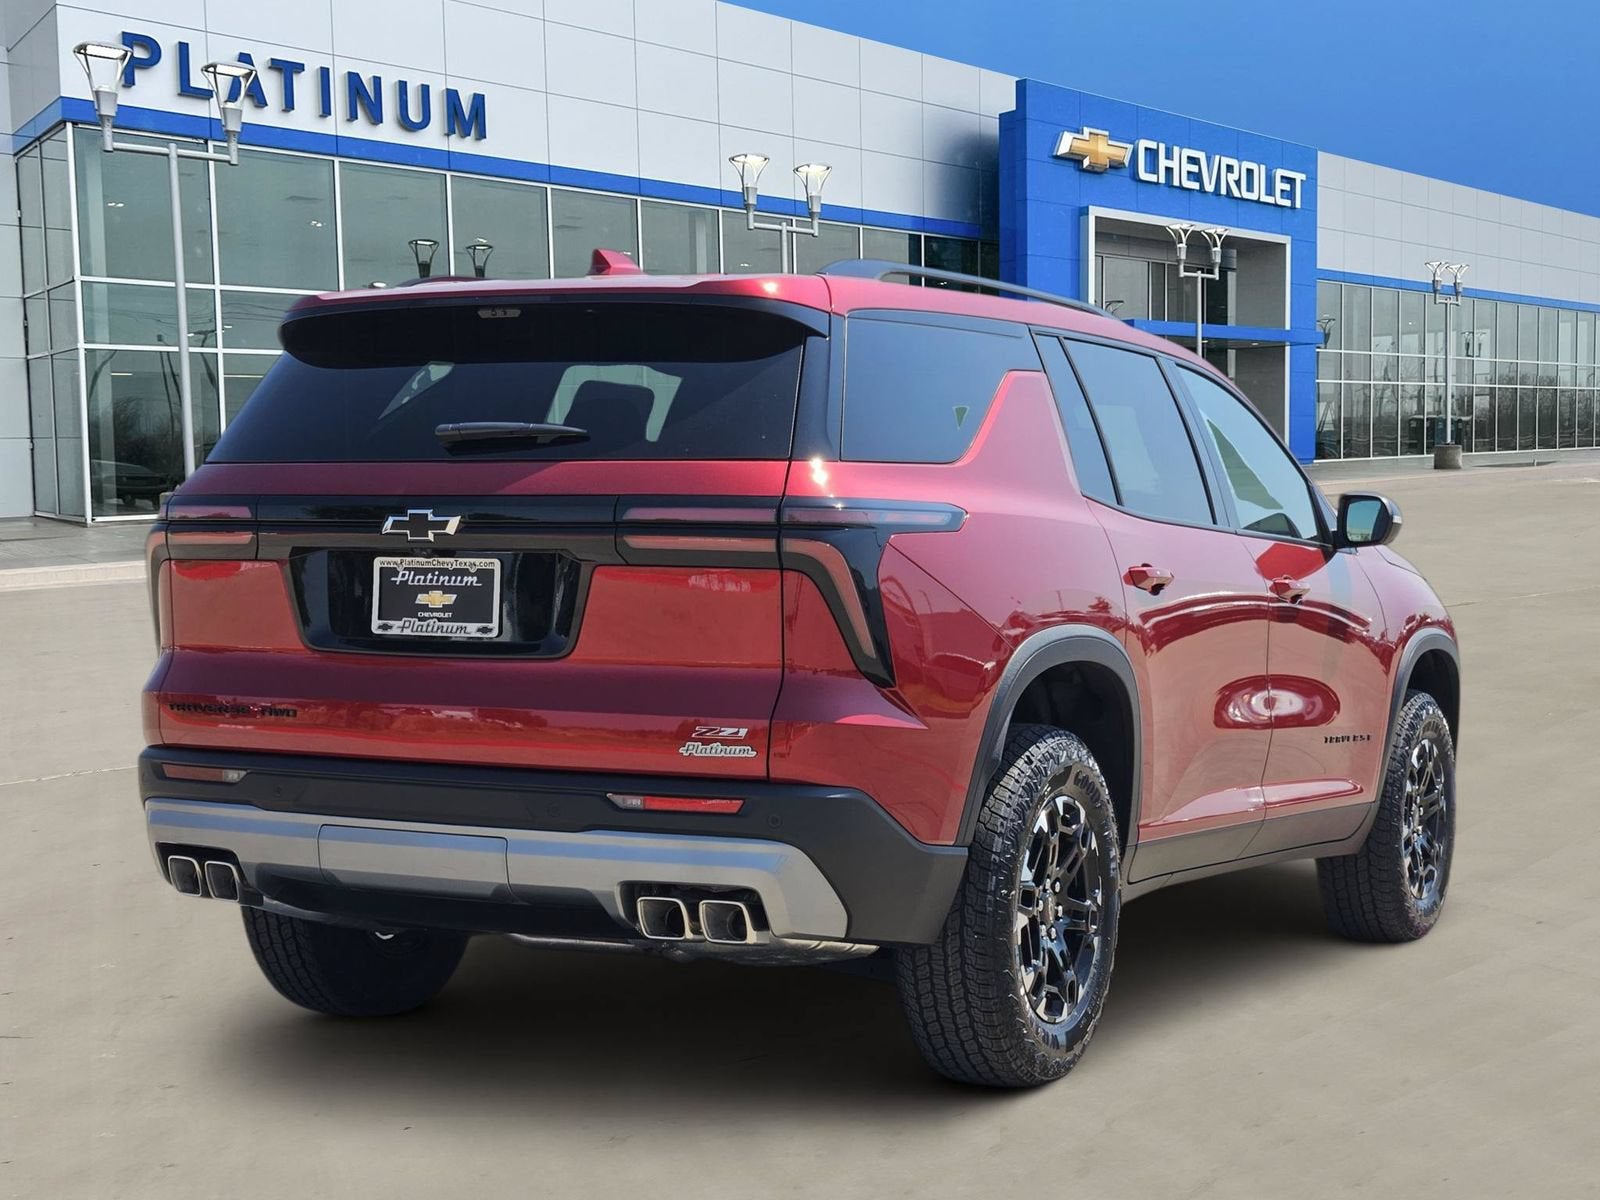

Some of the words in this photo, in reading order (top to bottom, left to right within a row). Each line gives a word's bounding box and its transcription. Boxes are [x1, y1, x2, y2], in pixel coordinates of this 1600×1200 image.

[119, 31, 488, 141] PLATINUM
[1136, 138, 1306, 209] CHEVROLET
[391, 571, 482, 586] Platinum
[397, 620, 471, 634] Platinum
[679, 742, 757, 756] Platinum
